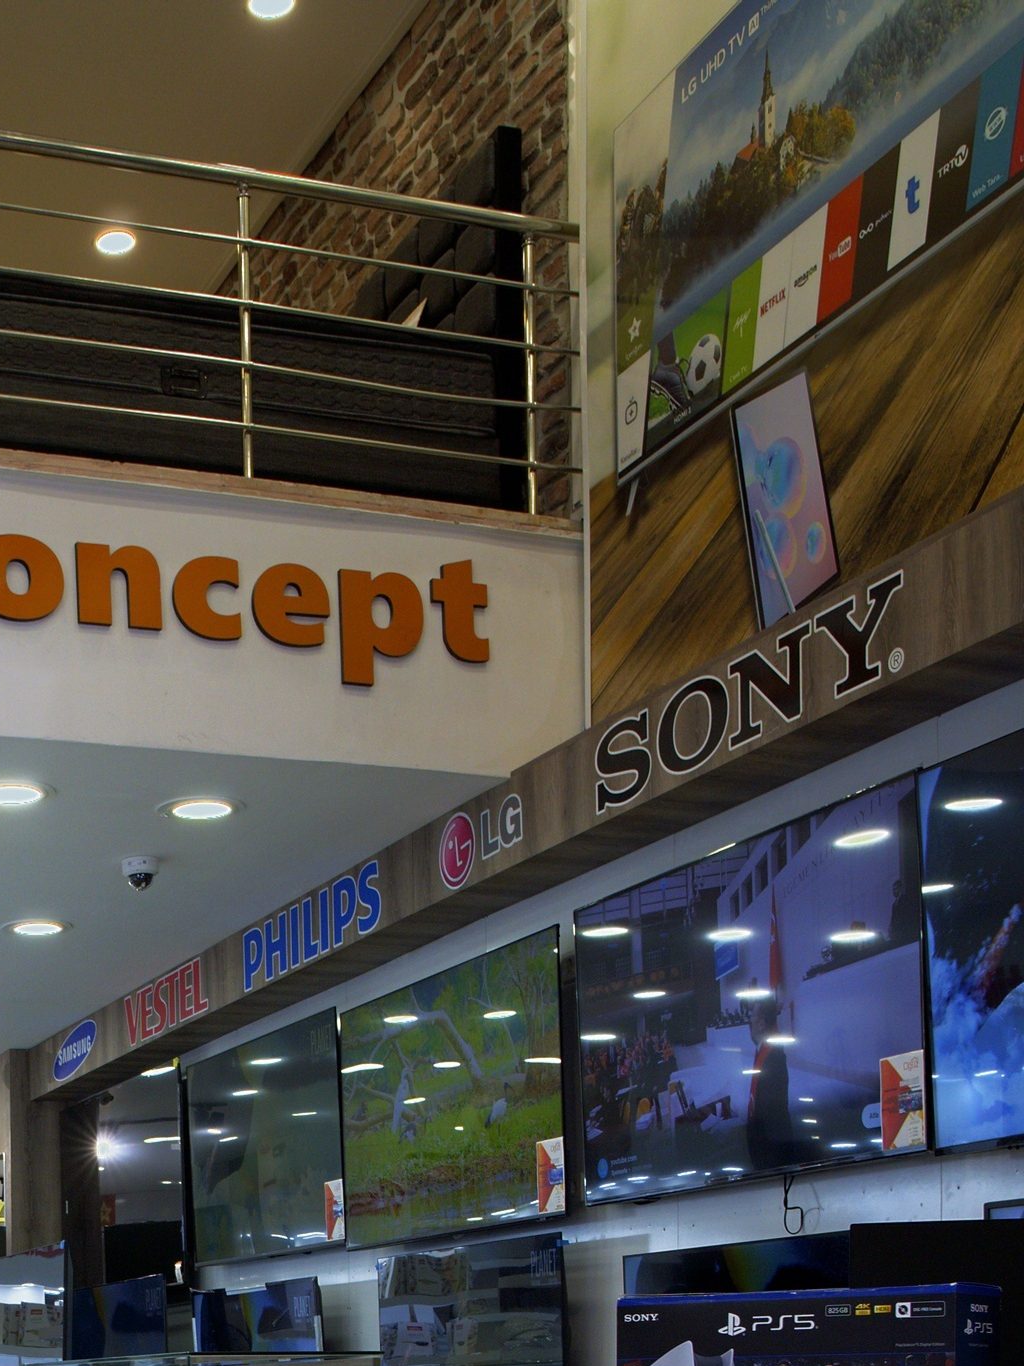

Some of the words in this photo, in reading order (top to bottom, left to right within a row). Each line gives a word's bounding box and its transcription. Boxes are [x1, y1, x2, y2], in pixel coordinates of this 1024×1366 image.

[680, 75, 697, 105] LG
[700, 48, 726, 84] UHD
[728, 25, 746, 56] TV
[759, 287, 786, 318] NETFLIX
[595, 569, 904, 816] SONY
[480, 793, 523, 861] LG
[242, 860, 382, 993] PHILIPS
[124, 957, 209, 1047] VESTEL
[57, 1034, 92, 1067] SAMSUNG
[530, 1248, 557, 1278] PLANET
[624, 1313, 659, 1323] SONY
[752, 1314, 815, 1332] PS5
[970, 1303, 989, 1313] SONY
[974, 1322, 994, 1334] PS5
